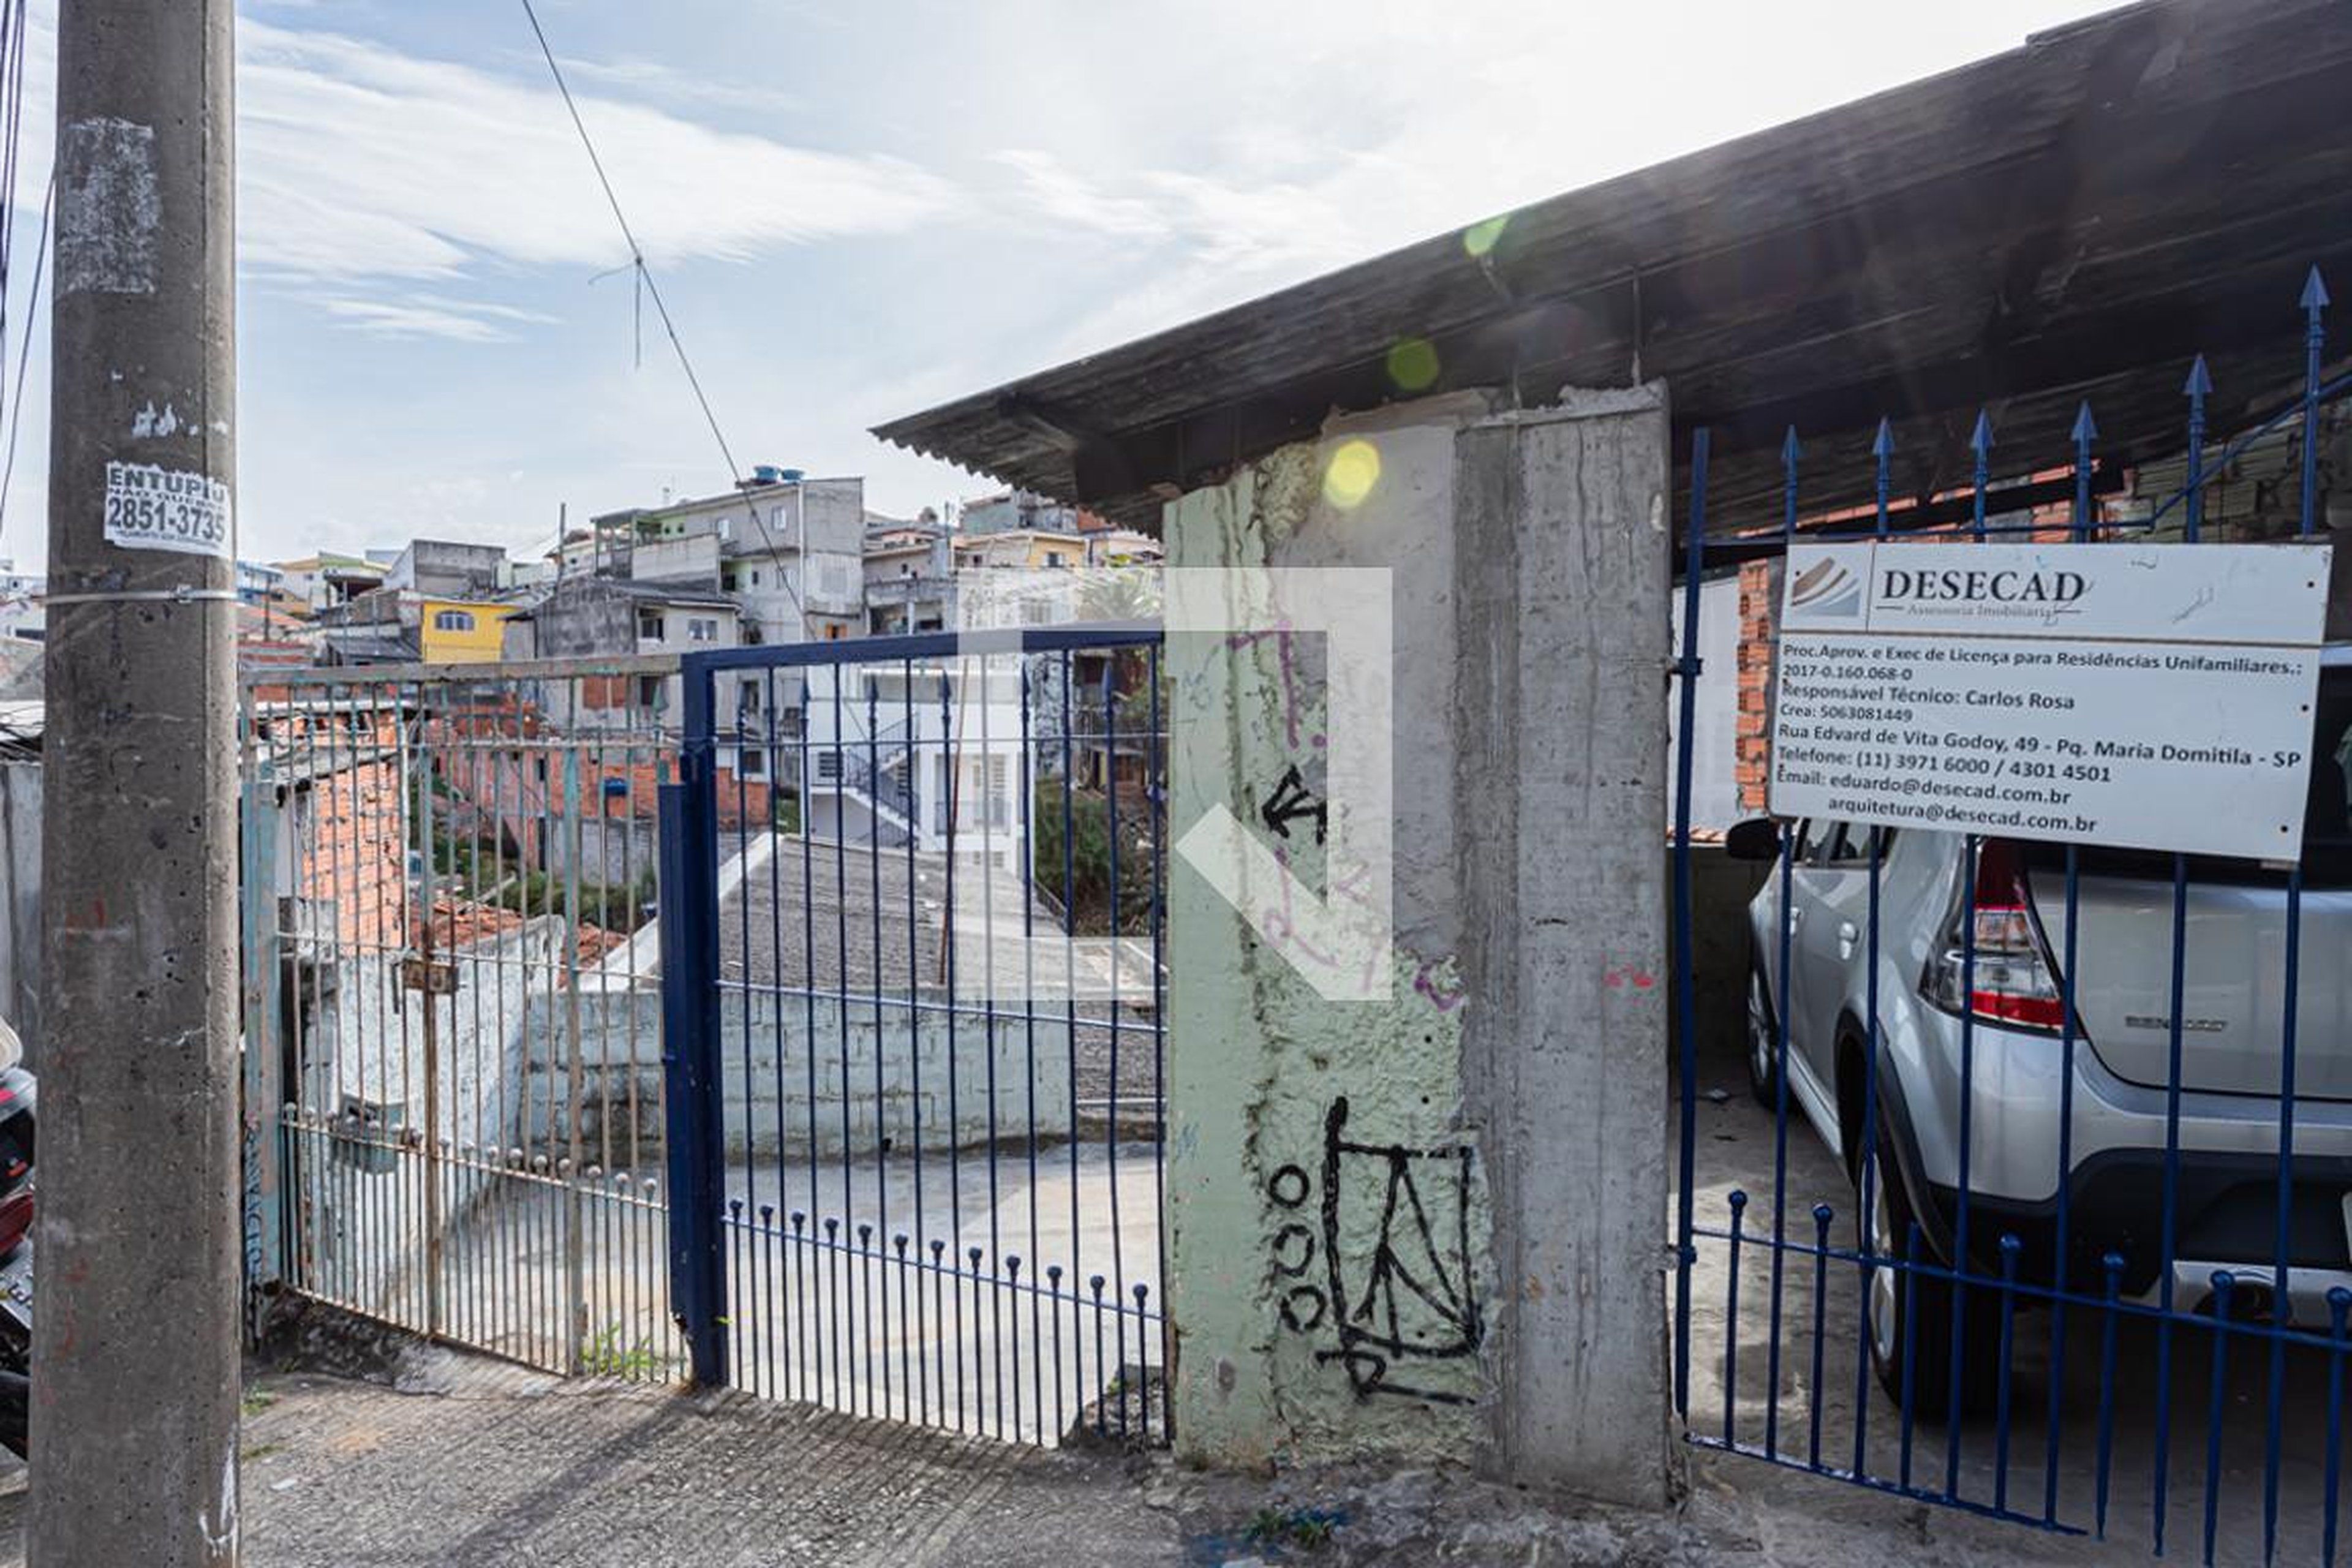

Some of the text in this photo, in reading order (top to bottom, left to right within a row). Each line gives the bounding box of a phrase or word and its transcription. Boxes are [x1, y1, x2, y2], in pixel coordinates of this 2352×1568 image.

[107, 497, 226, 542] 2851-3735
[1882, 570, 2085, 602] DESECAD
[1783, 663, 1913, 680] 2017-0.160.068-0
[1872, 648, 1882, 659] e
[1886, 646, 1922, 660] Exec
[1925, 647, 1945, 661] de
[1950, 648, 2010, 665] Licença
[2013, 652, 2052, 666] para
[2057, 651, 2161, 669] Residências
[1780, 704, 1913, 722] Crea: 5063081449
[1781, 684, 2075, 710] Responsável Técnico: Carlos Rosa
[1779, 723, 1809, 739] Rua
[1814, 726, 1871, 742] Edvard
[1875, 729, 1897, 744] de
[1903, 730, 1938, 746] Vita
[1943, 733, 2009, 753] Godoy,
[2014, 736, 2039, 752] 49
[2056, 738, 2087, 758] Pq.
[2094, 740, 2155, 760] Maria
[2160, 744, 2252, 765] Domitila
[2272, 751, 2302, 768] SP
[1777, 746, 2111, 782] Telefone: (11) 3971 6000 / 4301 4501
[1776, 768, 2071, 804] Email: eduardo@desecad.com.br
[1828, 797, 2097, 832] arquitetura@desecad.com.br
